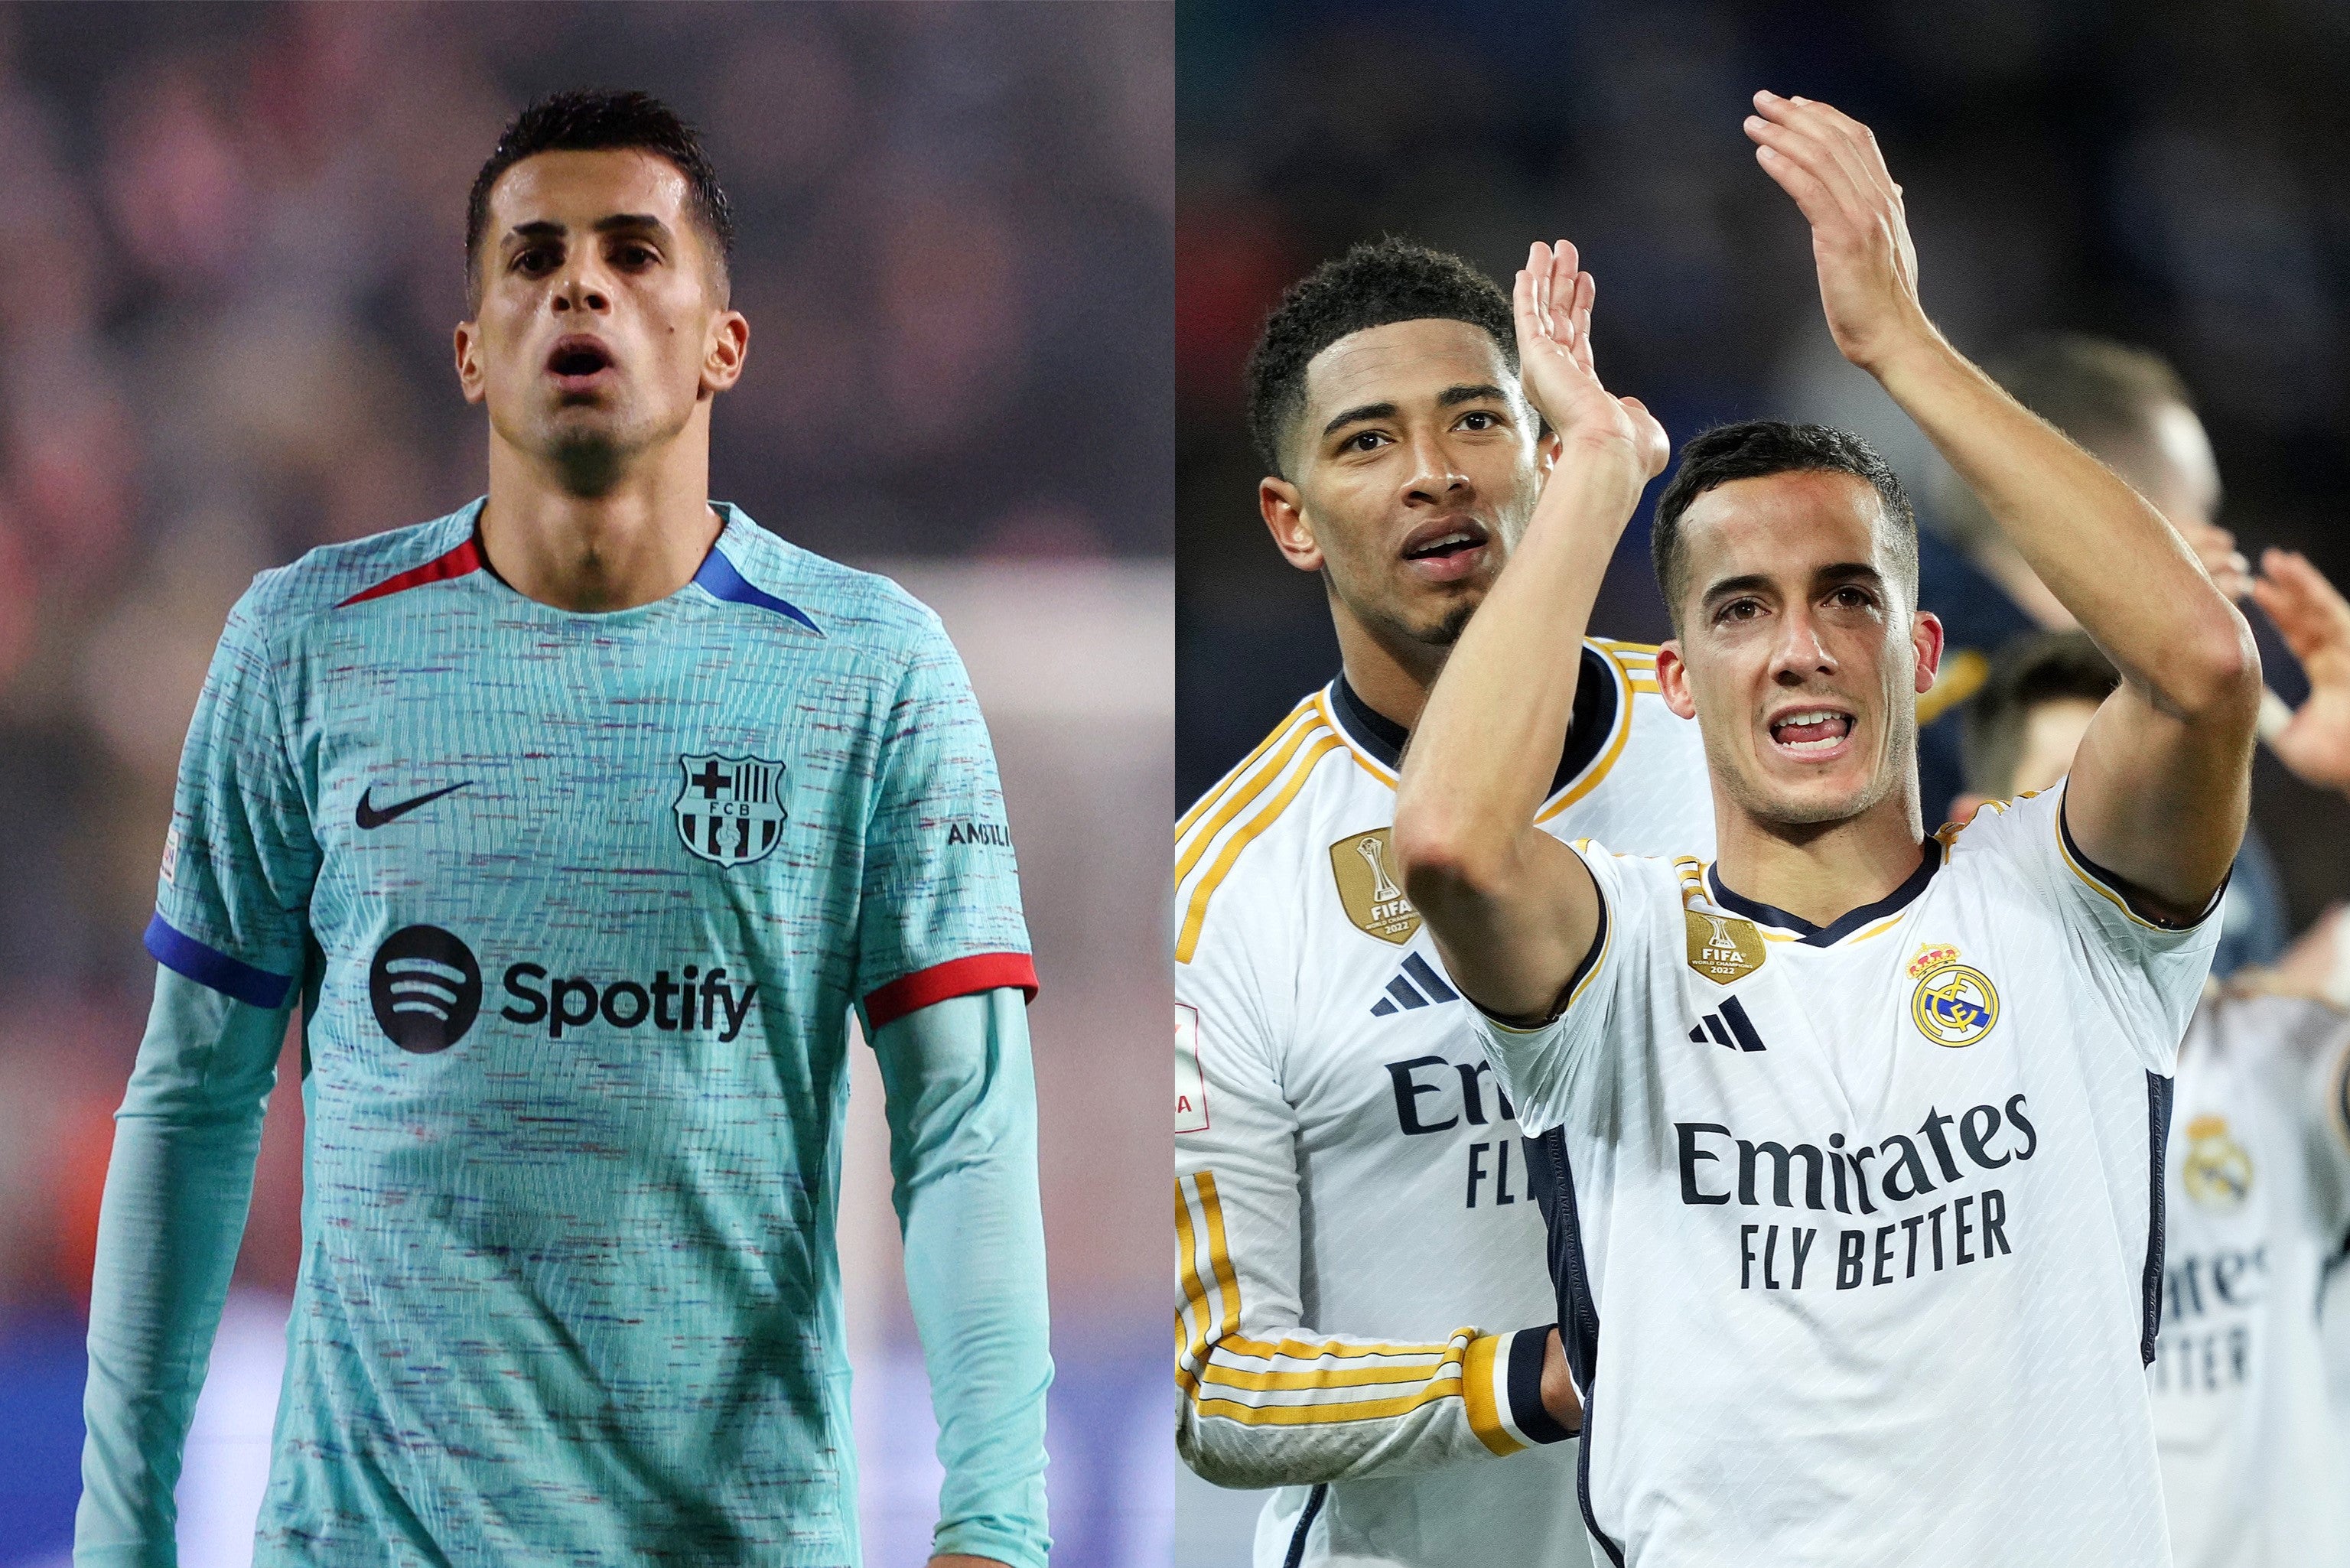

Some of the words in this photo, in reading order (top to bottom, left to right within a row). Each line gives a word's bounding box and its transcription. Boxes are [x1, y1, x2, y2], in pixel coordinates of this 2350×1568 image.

[709, 802, 750, 816] FCB
[1371, 899, 1412, 922] FIFA
[1385, 921, 1409, 935] 2022
[1703, 948, 1744, 963] FIFA
[500, 962, 758, 1043] Spotify
[1673, 1093, 2037, 1215] Emirates
[1740, 1225, 1817, 1290] FLY
[1836, 1189, 2012, 1290] BETTER
